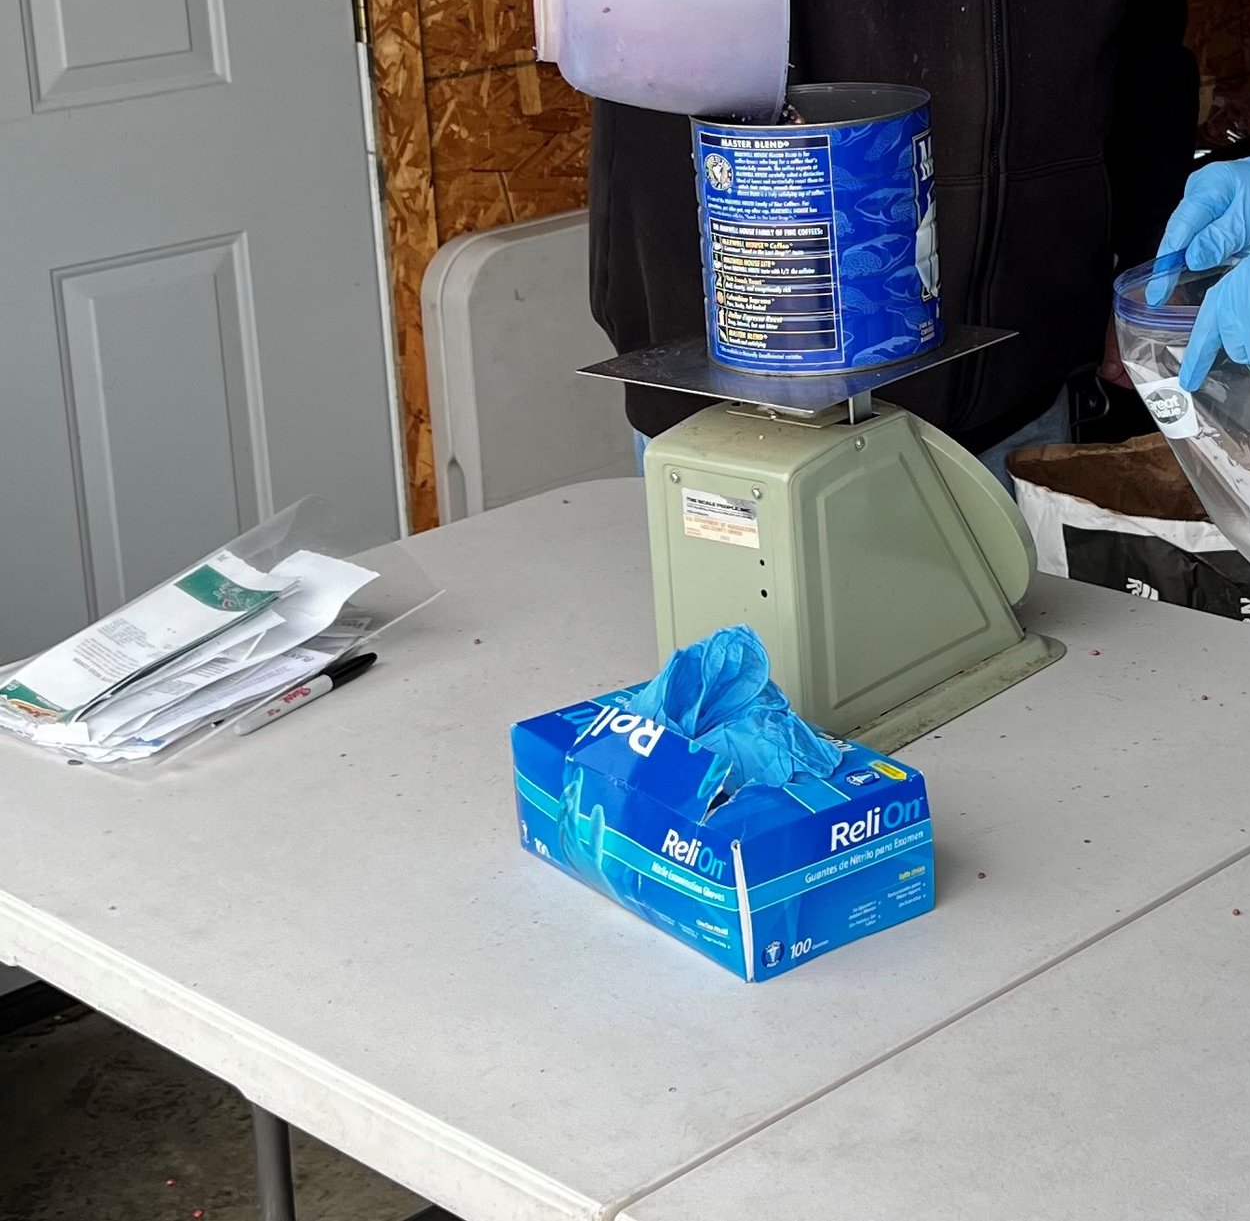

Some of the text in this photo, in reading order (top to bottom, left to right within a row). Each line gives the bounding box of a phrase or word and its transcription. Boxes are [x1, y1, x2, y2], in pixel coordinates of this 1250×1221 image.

[721, 138, 752, 149] MASTER
[1146, 394, 1180, 412] Great
[1155, 407, 1182, 418] Value
[830, 797, 921, 852] ReliOn
[661, 828, 723, 880] ReliOn
[804, 830, 924, 884] Guantes de Nitrilo para Examen
[790, 937, 813, 960] 100
